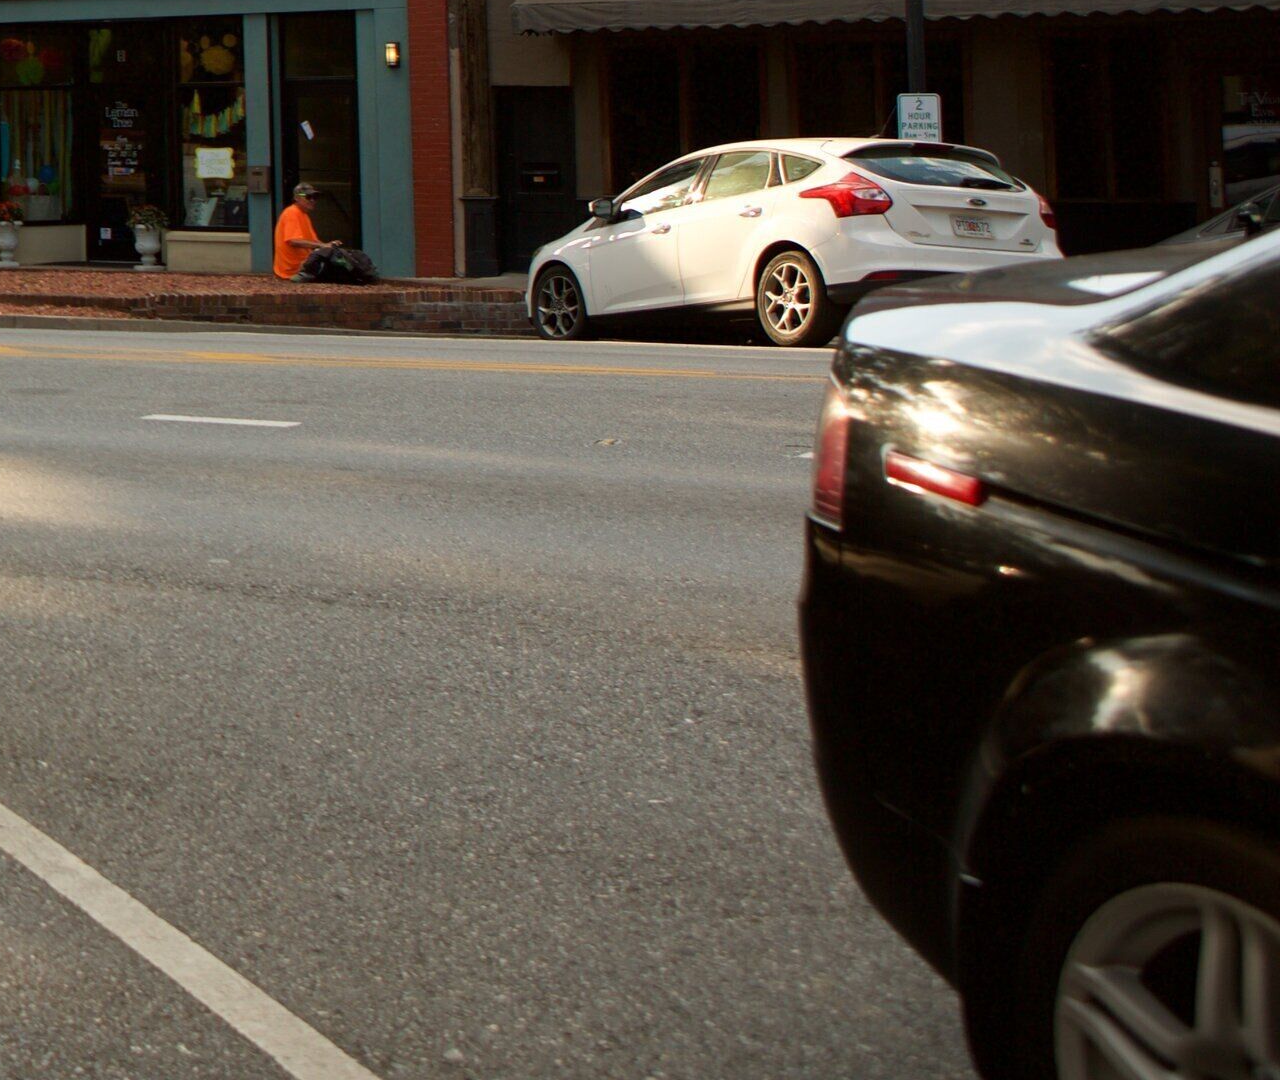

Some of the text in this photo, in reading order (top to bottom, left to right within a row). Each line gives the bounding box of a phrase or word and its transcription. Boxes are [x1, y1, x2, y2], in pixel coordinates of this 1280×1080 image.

[915, 99, 923, 111] 2
[907, 112, 930, 120] HOUR
[902, 122, 938, 130] PARKING
